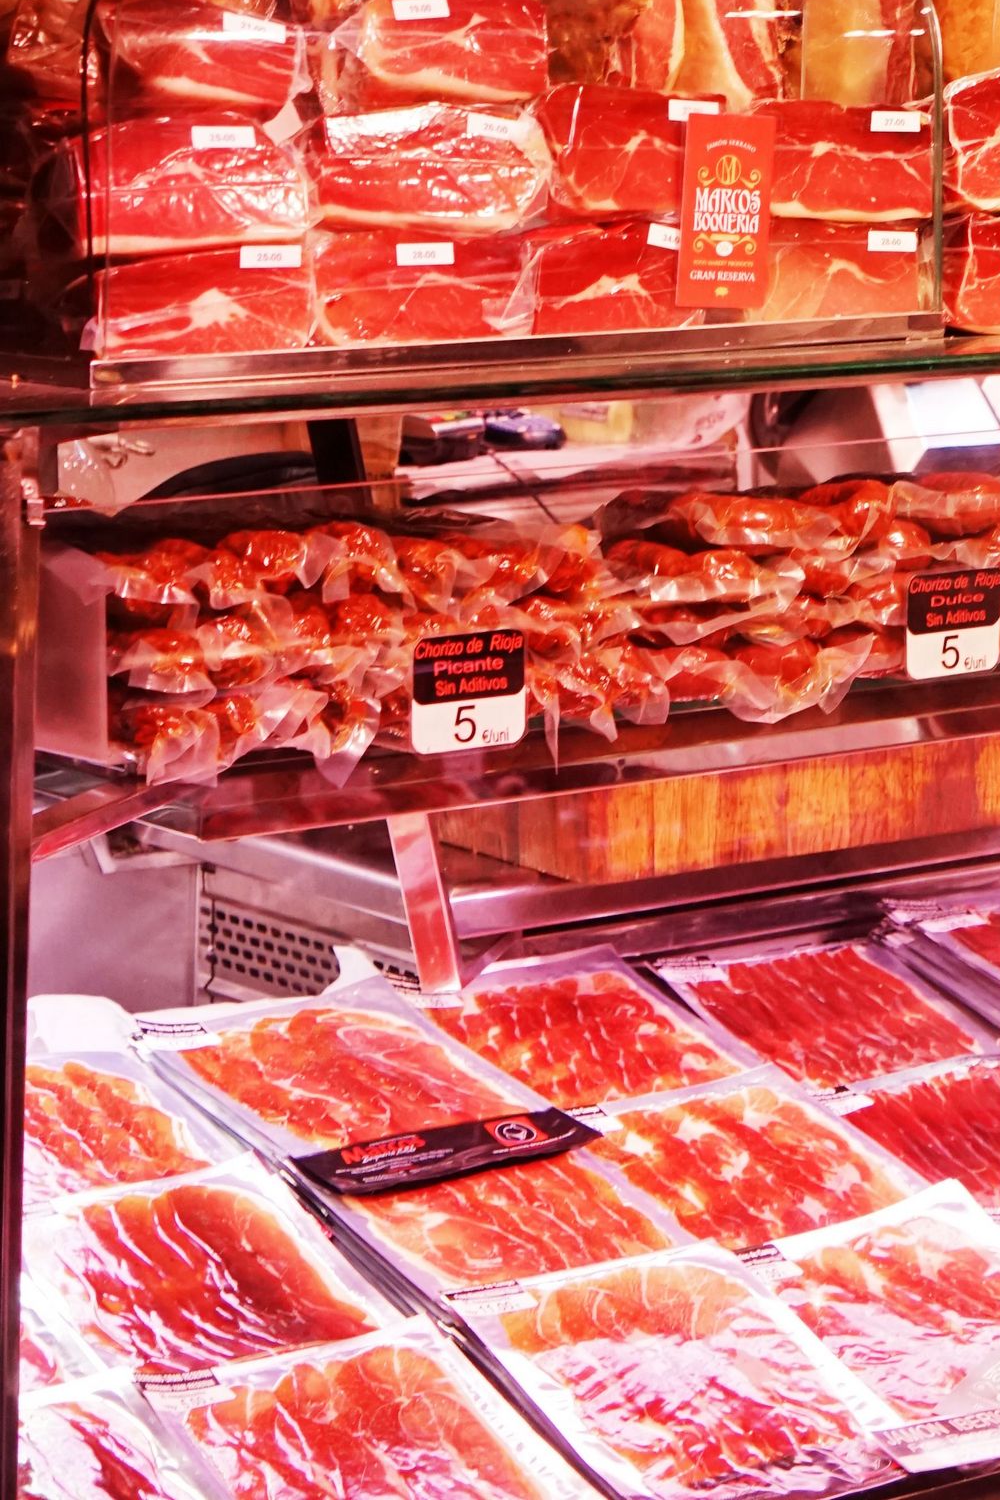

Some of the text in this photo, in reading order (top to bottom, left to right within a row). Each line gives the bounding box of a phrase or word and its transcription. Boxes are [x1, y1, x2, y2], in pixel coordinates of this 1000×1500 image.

[694, 186, 761, 215] MARCOS
[692, 211, 761, 234] BOQUERIA
[689, 269, 756, 283] GRAN RESERVA
[909, 576, 952, 595] Chorizo
[953, 574, 969, 589] de
[930, 593, 985, 608] Dulce
[926, 609, 987, 628] Sin Aditivos
[415, 632, 524, 660] Chorizo de Rioja
[941, 634, 960, 670] 5
[433, 656, 505, 677] Picante
[435, 675, 508, 697] Sin Aditivos
[454, 704, 477, 743] 5
[883, 1420, 950, 1447] JAMON
